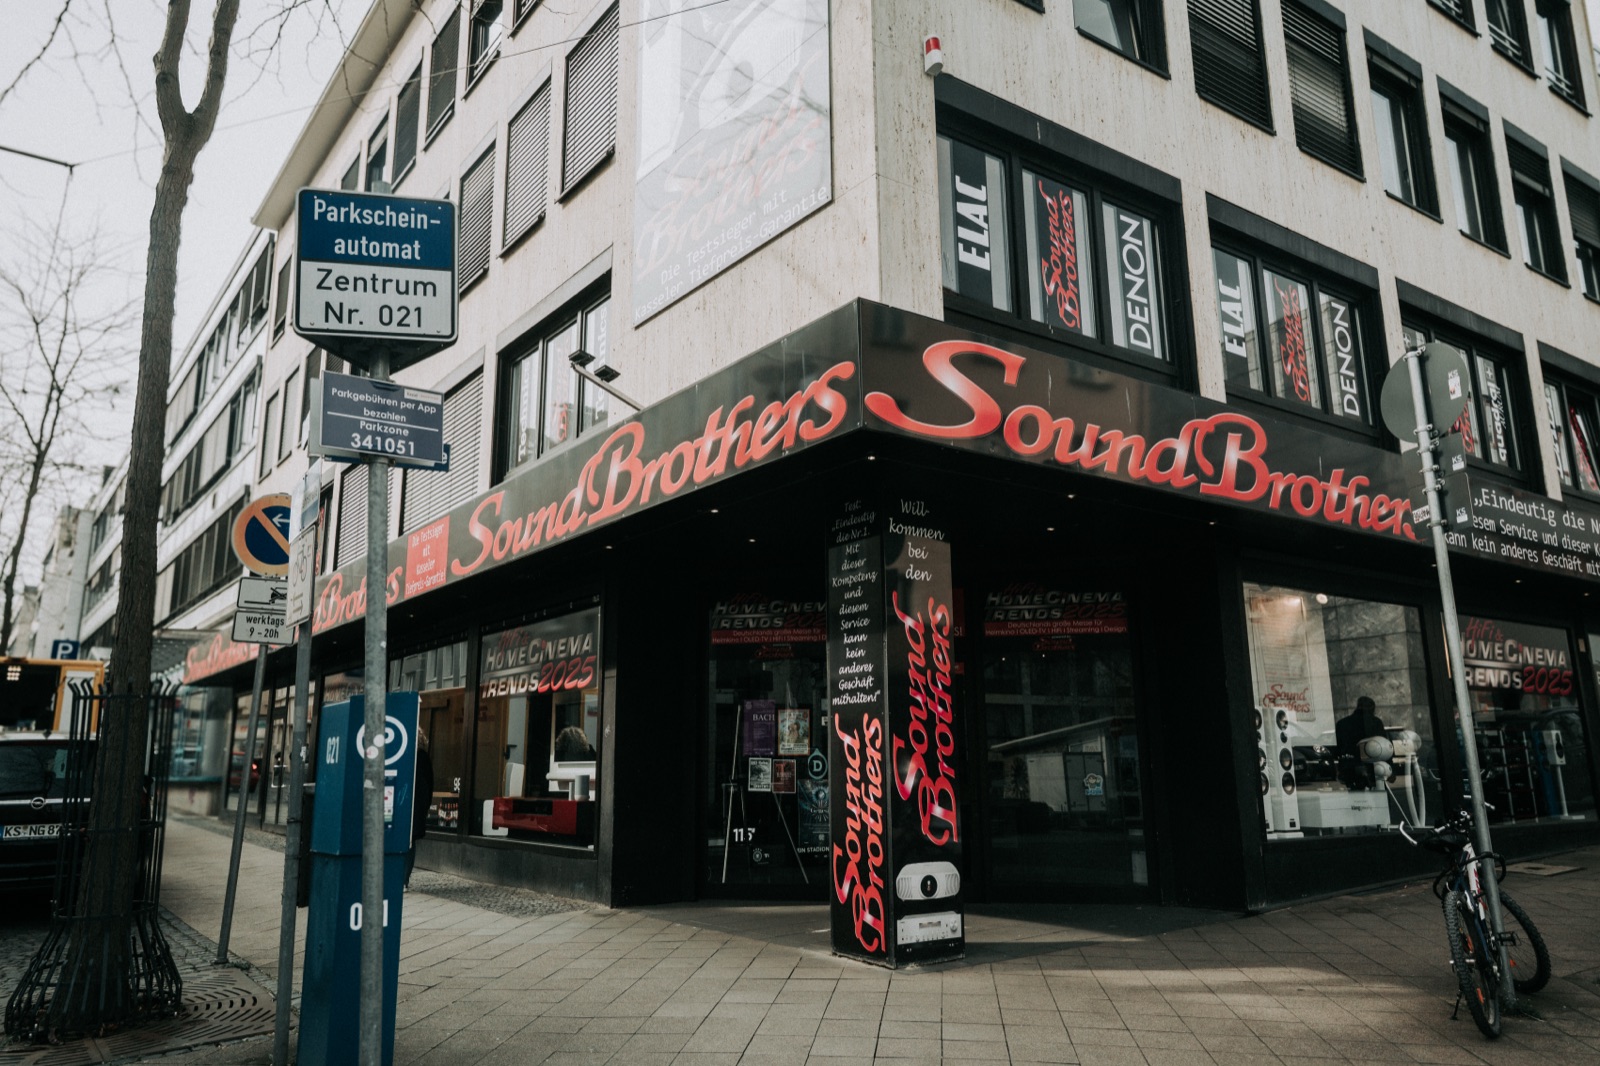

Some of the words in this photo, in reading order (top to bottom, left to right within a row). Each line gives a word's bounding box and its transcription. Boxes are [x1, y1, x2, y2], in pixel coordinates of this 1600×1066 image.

[313, 198, 441, 230] Parkschein-
[955, 174, 991, 272] ELAC
[334, 237, 421, 260] automat
[660, 263, 681, 285] Die
[686, 210, 756, 268] Testsieger
[763, 190, 788, 217] mit
[1038, 180, 1063, 296] Sound
[634, 281, 684, 322] Kasseler
[689, 186, 828, 284] Tiefpreis-Garantie
[1056, 189, 1081, 329] Brothers
[316, 268, 437, 297] Zentrum
[1119, 214, 1152, 350] DENON
[324, 301, 364, 326] Nr.
[378, 304, 423, 328] 021
[1218, 278, 1247, 358] ELAC
[1274, 277, 1296, 376] Sound
[1288, 284, 1311, 402] Brothers
[1331, 301, 1360, 417] DENON
[331, 387, 398, 408] Parkgebühren
[400, 400, 416, 412] per
[417, 401, 437, 415] App
[363, 407, 407, 422] bezahlen
[1487, 381, 1508, 462] quadral
[359, 420, 409, 437] Parkzone
[350, 433, 415, 456] 341051
[900, 498, 930, 517] Will-
[889, 517, 945, 541] kommen
[1562, 510, 1585, 531] die
[836, 531, 850, 544] die
[1472, 515, 1496, 532] esem
[1500, 519, 1538, 542] Service
[1542, 531, 1558, 547] und
[1561, 534, 1591, 554] dieser
[845, 542, 860, 555] Mit
[907, 542, 929, 560] bei
[1471, 533, 1496, 554] kein
[1500, 542, 1539, 563] anderes
[1542, 550, 1583, 572] Geschäft
[841, 558, 867, 571] dieser
[905, 564, 933, 582] den
[831, 571, 878, 588] Kompetenz
[844, 586, 863, 600] und
[839, 602, 869, 616] diesem
[246, 615, 285, 628] werktags
[249, 627, 255, 637] 9
[264, 628, 279, 639] 20h
[840, 617, 871, 631] Service
[843, 632, 868, 645] kann
[59, 642, 74, 659] P
[845, 646, 866, 659] kein
[538, 655, 597, 694] 2025
[838, 661, 874, 675] anderes
[838, 676, 874, 692] Geschäft
[1465, 667, 1523, 689] RENDS
[1521, 666, 1574, 696] 2025
[892, 590, 929, 801] Sound
[1270, 684, 1309, 703] Sound
[752, 713, 775, 722] BACH
[917, 597, 958, 847] Brothers
[833, 712, 861, 904] Sound
[4, 826, 22, 837] KS
[29, 825, 46, 836] NG
[852, 712, 886, 953] Brothers
[350, 899, 388, 931] 01
